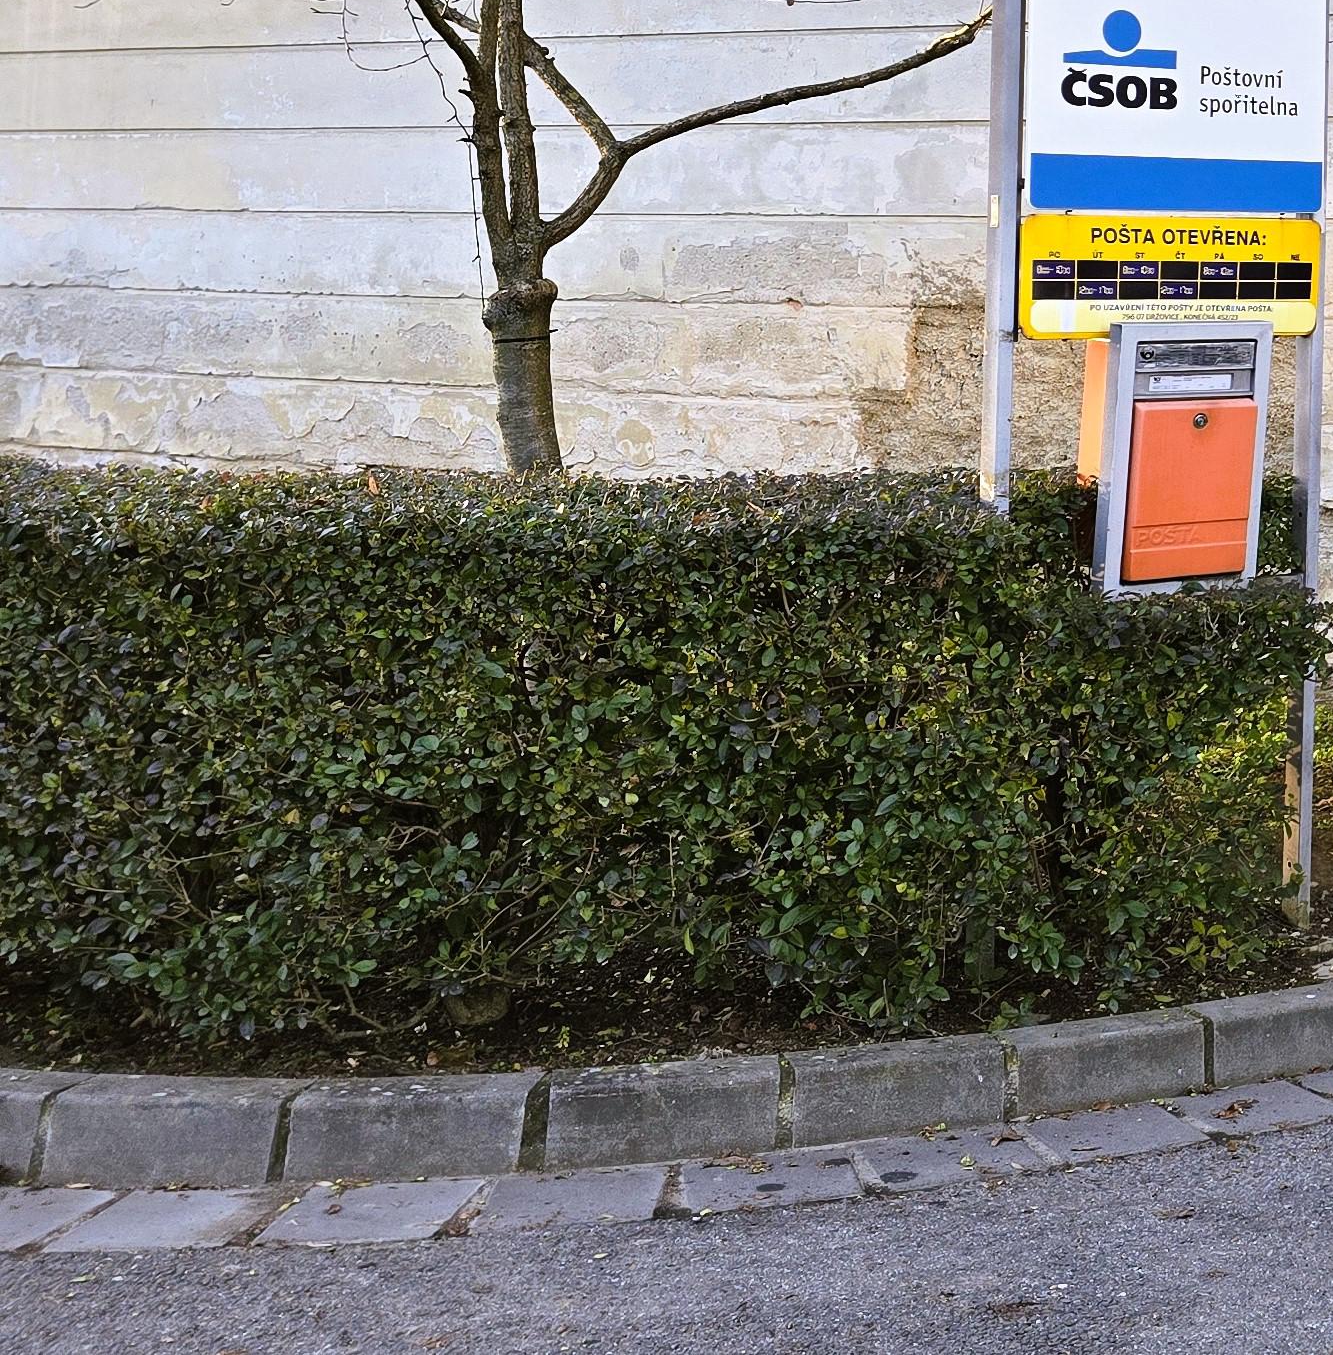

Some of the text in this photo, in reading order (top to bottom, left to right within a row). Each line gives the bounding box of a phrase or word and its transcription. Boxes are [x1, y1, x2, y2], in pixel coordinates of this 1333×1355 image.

[1199, 65, 1284, 89] Poštovní
[1061, 67, 1178, 110] ČSOB
[1199, 94, 1299, 118] spořitelna
[1090, 224, 1267, 247] POŠTA OTEVŘENA:
[1048, 250, 1061, 259] PO
[1092, 249, 1104, 259] ÚT
[1135, 251, 1145, 259] ST
[1175, 250, 1186, 260] ČT
[1252, 253, 1264, 261] SO
